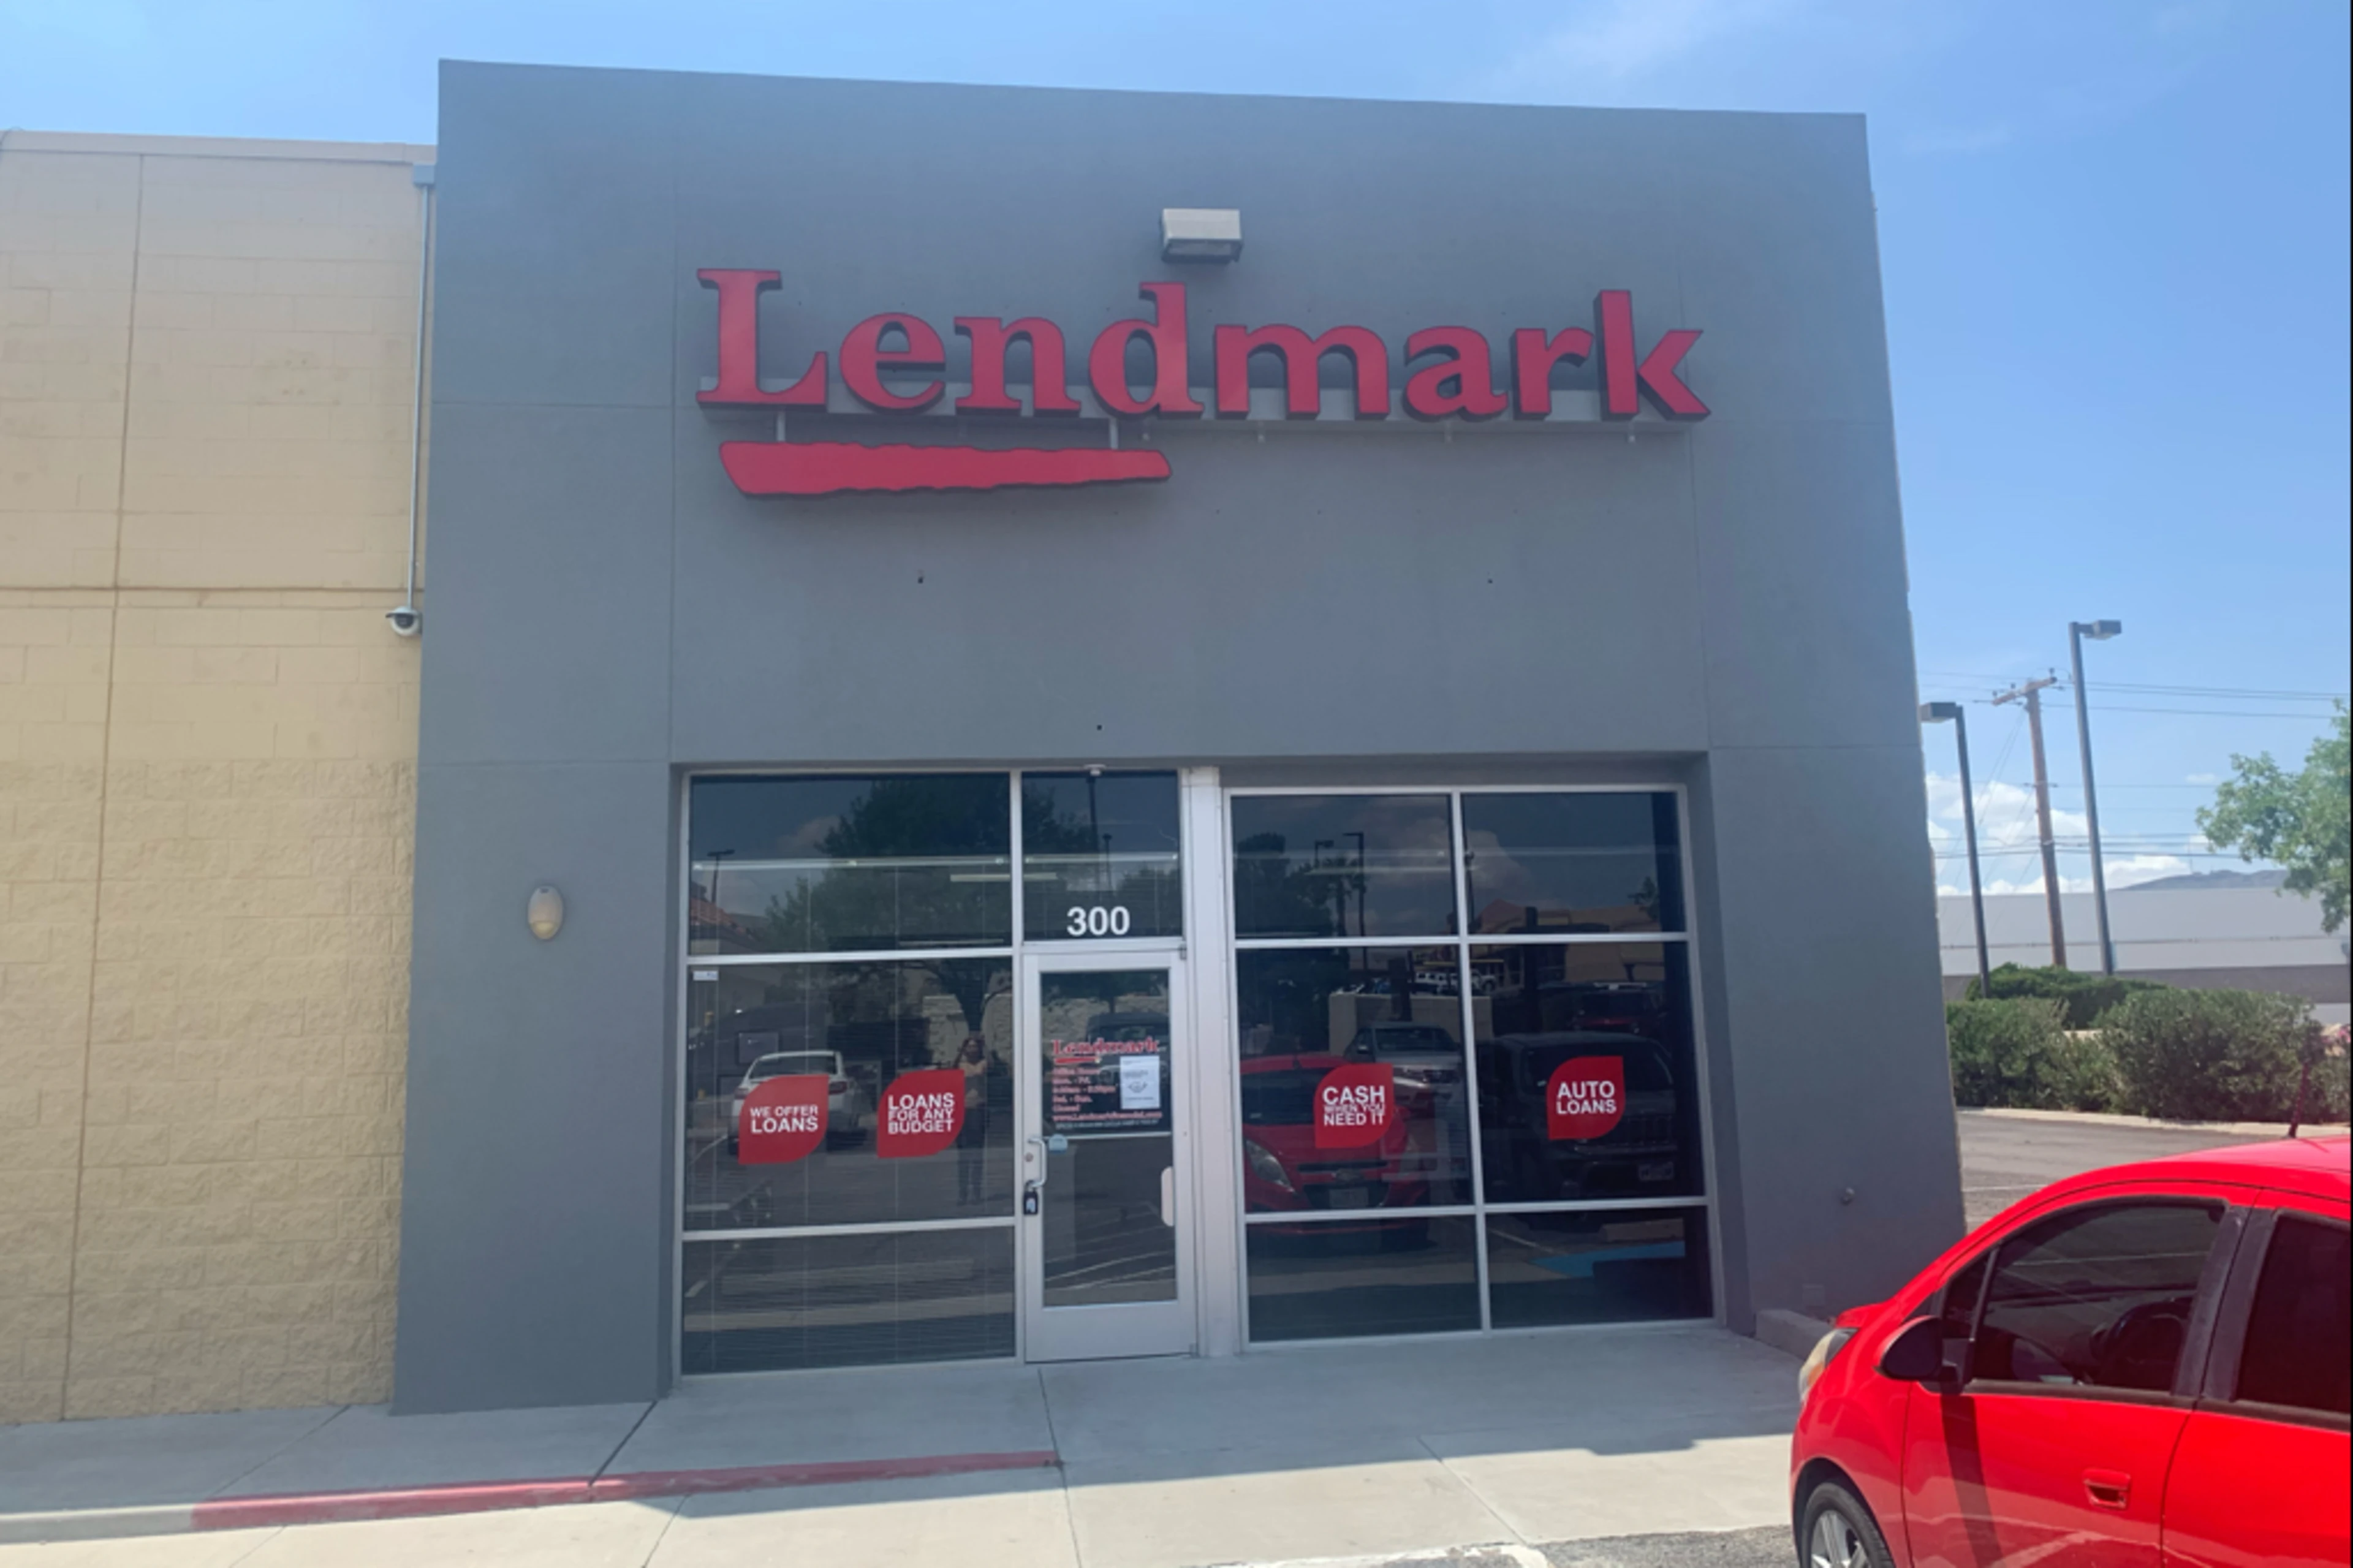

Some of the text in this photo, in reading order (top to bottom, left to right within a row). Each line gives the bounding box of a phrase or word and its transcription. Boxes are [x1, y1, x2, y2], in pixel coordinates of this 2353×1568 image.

[695, 268, 1712, 422] Lendmark
[1066, 905, 1131, 936] 300
[1051, 1037, 1159, 1054] Lendmark
[1322, 1085, 1385, 1105] CASH
[1558, 1080, 1615, 1099] AUTO
[888, 1092, 955, 1110] LOANS
[1362, 1103, 1385, 1115] YOU
[1556, 1099, 1616, 1115] LOANS
[750, 1104, 819, 1118] WE OFFER
[888, 1107, 954, 1121] FOR ANY
[1324, 1110, 1384, 1126] NEED IT
[751, 1116, 819, 1134] LOANS
[888, 1119, 954, 1134] BUDGET
